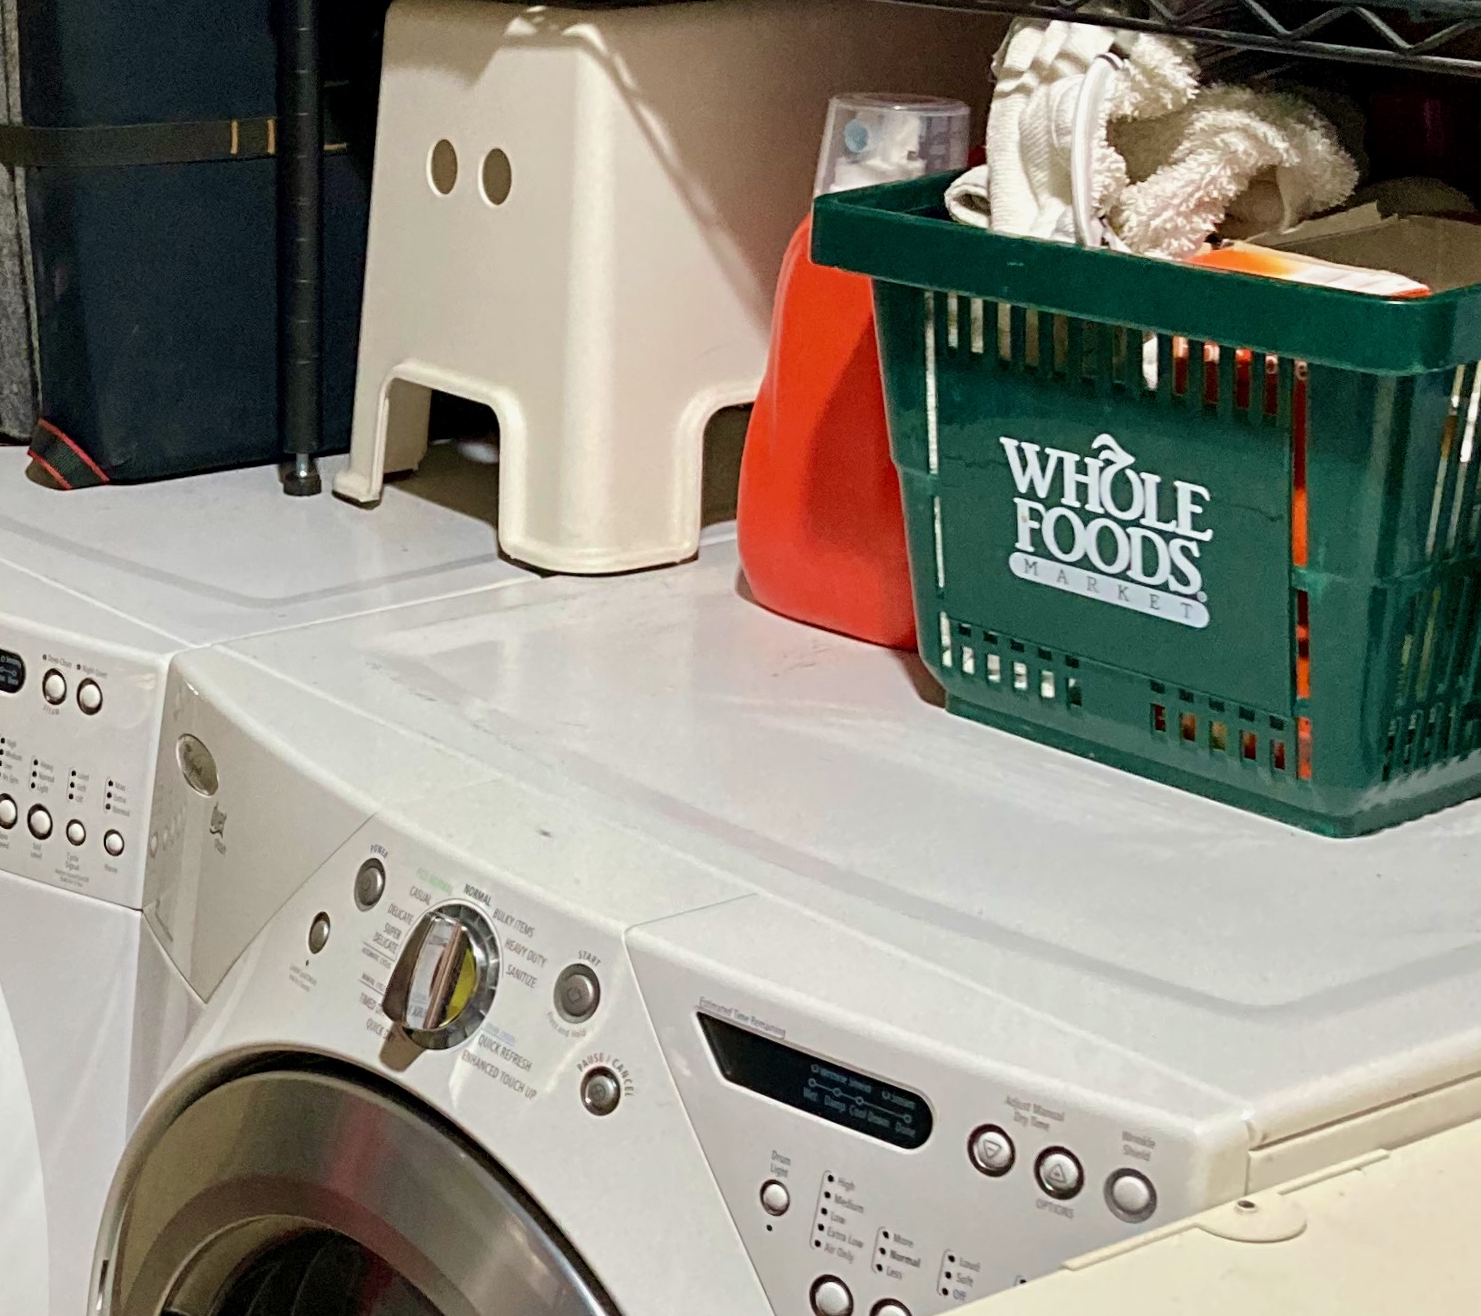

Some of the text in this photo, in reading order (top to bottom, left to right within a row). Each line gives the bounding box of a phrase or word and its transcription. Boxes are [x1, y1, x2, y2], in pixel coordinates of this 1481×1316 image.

[999, 435, 1214, 541] WHOLE
[1013, 496, 1202, 597] FOODS
[1023, 557, 1195, 621] MARKET
[409, 885, 432, 906] CASUAL
[463, 883, 492, 907] NORMAL
[388, 903, 414, 925] DELICATE
[492, 908, 536, 939] BULKY ITEMS
[373, 931, 400, 954] DELICATE
[384, 922, 403, 941] SUPER
[505, 938, 548, 969] HEAVY DUTY
[578, 950, 602, 967] START
[505, 964, 538, 989] SANITIZE
[478, 1035, 533, 1072] QUICK REFRESH
[461, 1050, 538, 1101] ENHANCED TOUCH UP
[577, 1052, 605, 1072] PAUSE
[611, 1058, 635, 1097] CANCEL
